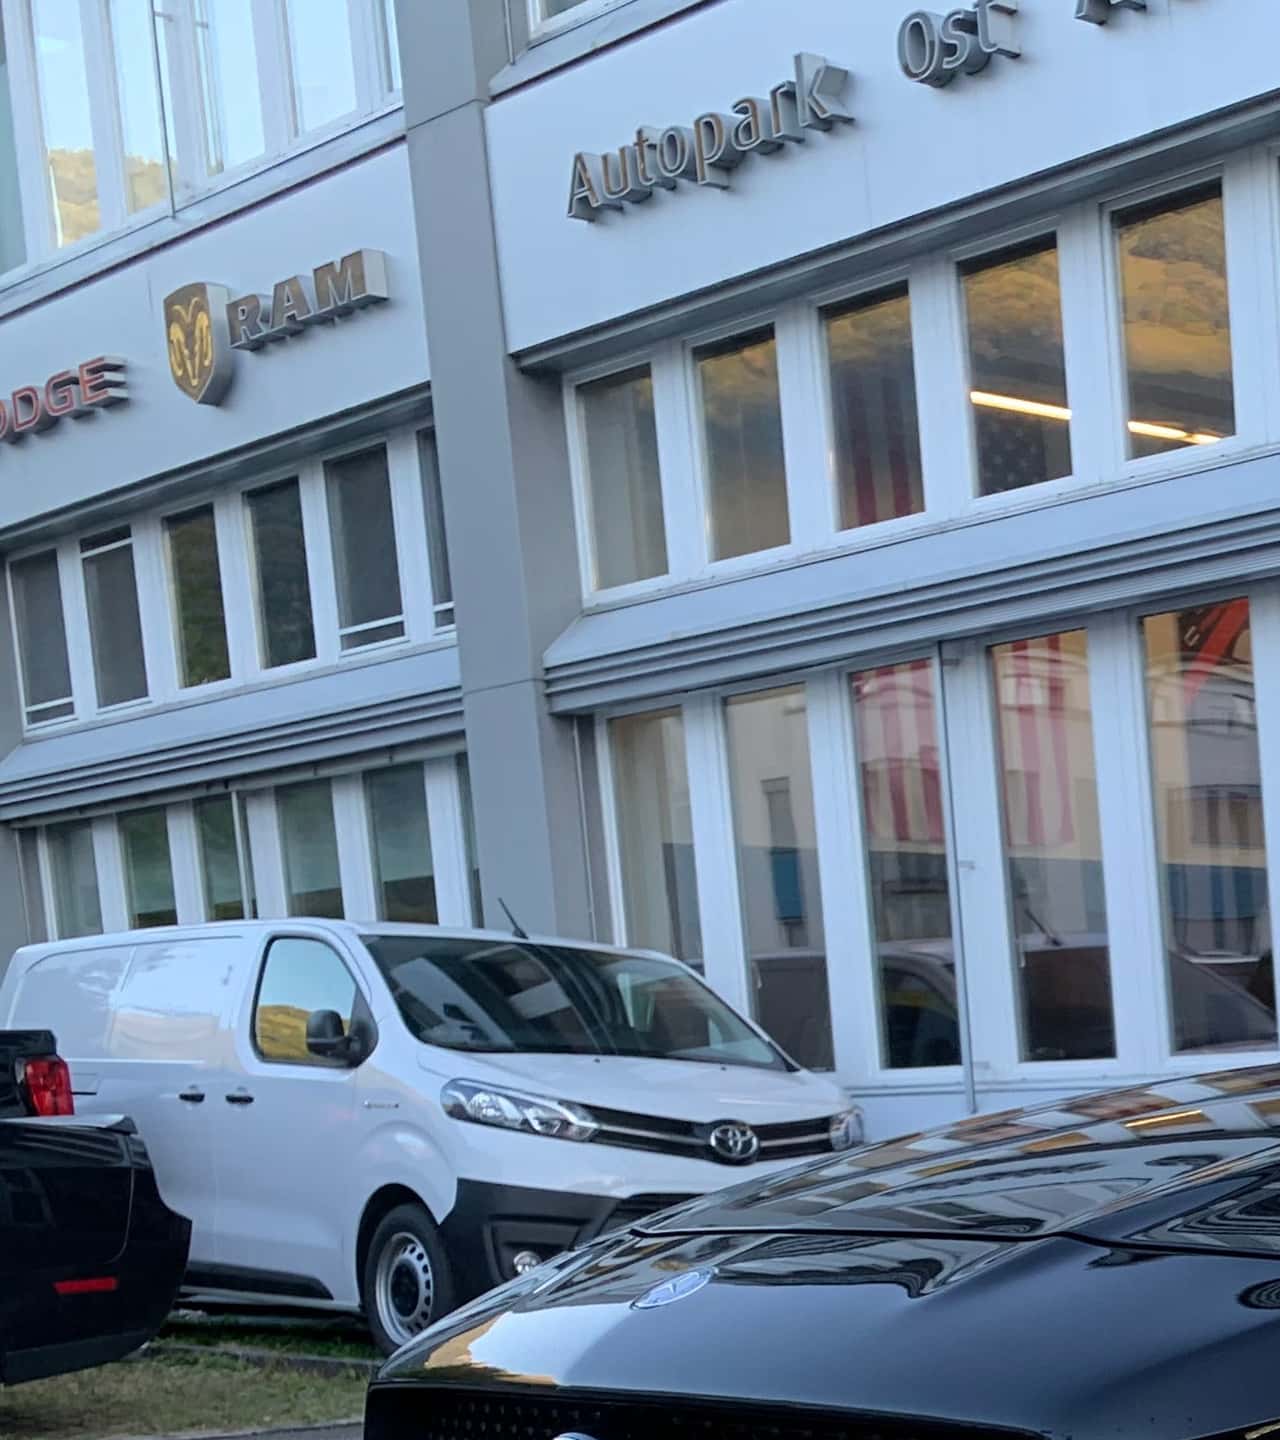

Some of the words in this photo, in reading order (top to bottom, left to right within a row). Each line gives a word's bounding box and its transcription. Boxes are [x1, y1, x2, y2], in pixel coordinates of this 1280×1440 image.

[567, 52, 850, 222] Autopark
[897, 0, 1016, 86] Ost
[226, 248, 388, 352] RAM
